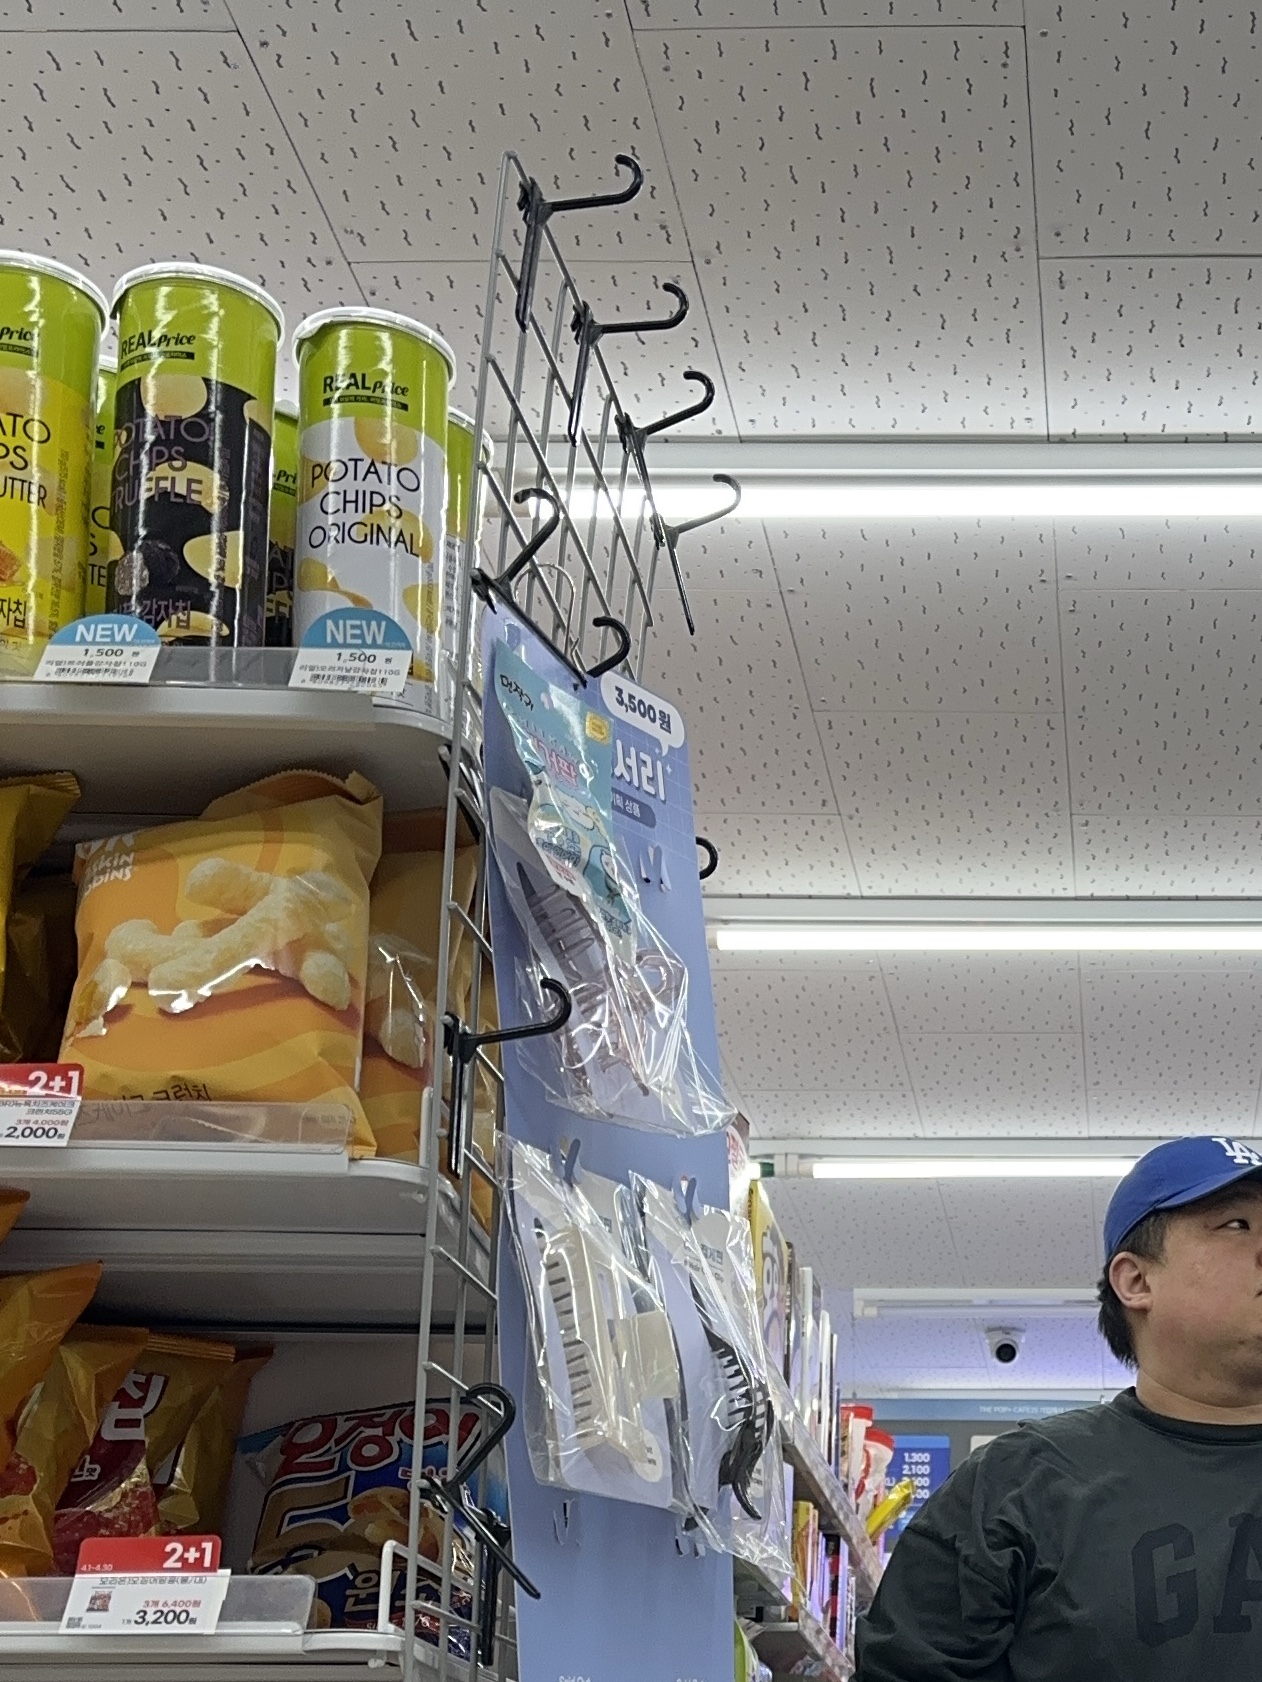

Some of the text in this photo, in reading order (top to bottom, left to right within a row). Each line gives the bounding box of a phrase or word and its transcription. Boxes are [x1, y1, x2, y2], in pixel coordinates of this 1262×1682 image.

[115, 445, 188, 483] CHIPS
[310, 457, 421, 493] POTATO
[111, 476, 204, 512] TRUFFLE
[319, 490, 403, 521] CHIPS
[308, 521, 420, 558] ORIGINAL
[75, 623, 138, 643] NEW
[326, 619, 387, 645] NEW
[83, 648, 124, 658] 1,500
[336, 652, 377, 663] 1,500
[614, 685, 673, 735] 3,500원
[28, 1070, 80, 1098] 2+1
[163, 1541, 213, 1569] 2+1
[134, 1609, 198, 1626] 3,200원
